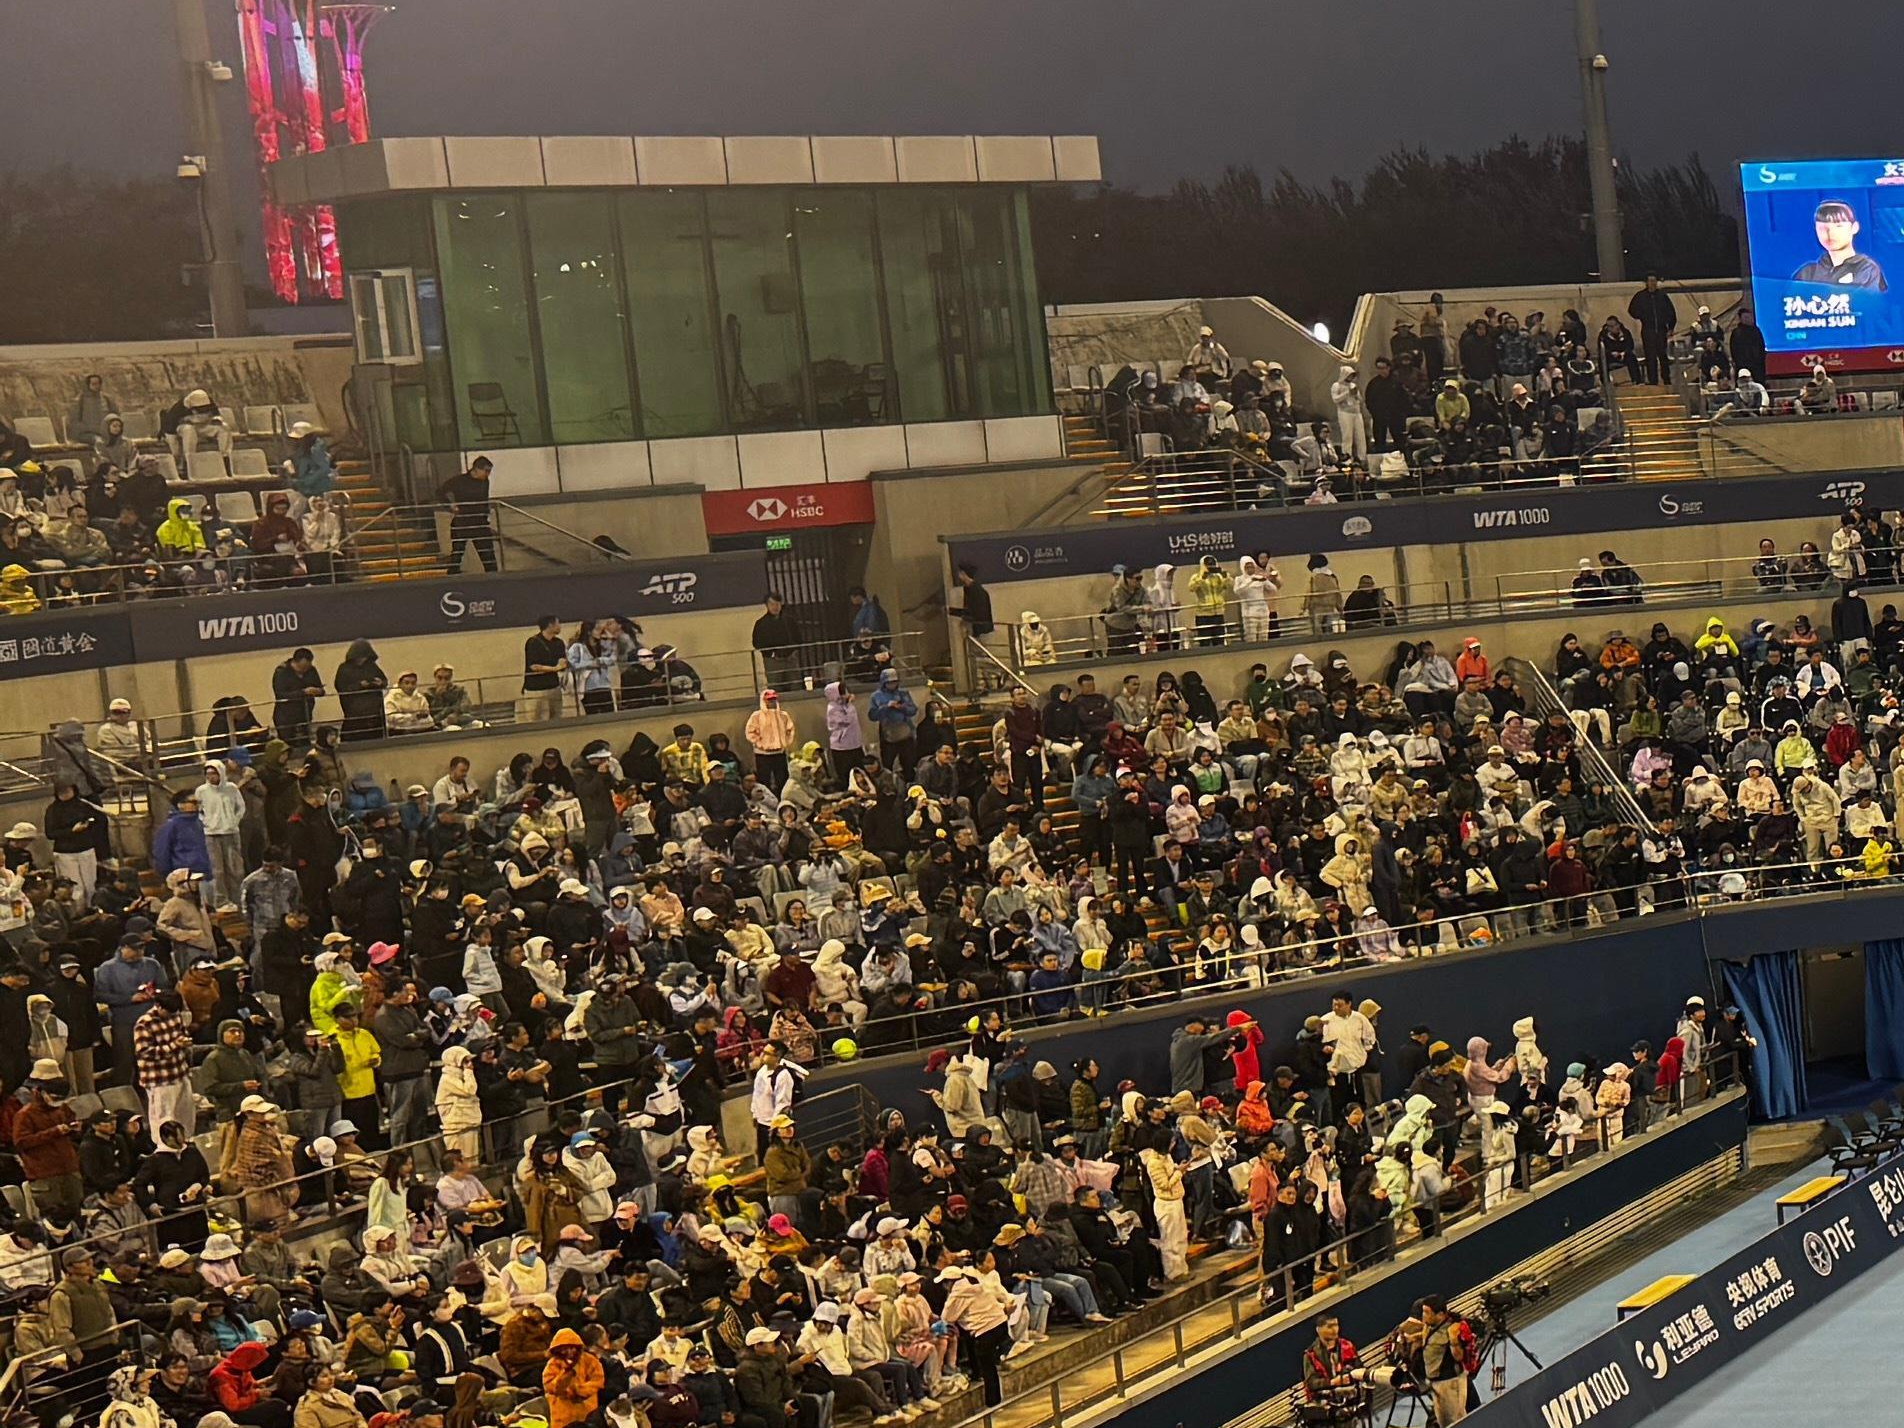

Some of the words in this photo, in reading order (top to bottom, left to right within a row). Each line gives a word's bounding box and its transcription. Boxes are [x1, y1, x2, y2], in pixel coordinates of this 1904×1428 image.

[1827, 315, 1856, 327] SUN
[1817, 481, 1866, 499] ATP
[1473, 510, 1517, 528] WTA
[1519, 507, 1550, 525] 1000
[638, 572, 698, 595] ATP
[671, 592, 695, 604] 500
[198, 615, 256, 640] WTA
[258, 611, 299, 634] 1000
[1823, 1216, 1856, 1260] PIF
[1726, 1256, 1783, 1308] 央视体育
[1756, 1279, 1795, 1318] SPORTS
[1587, 1361, 1630, 1409] 1000
